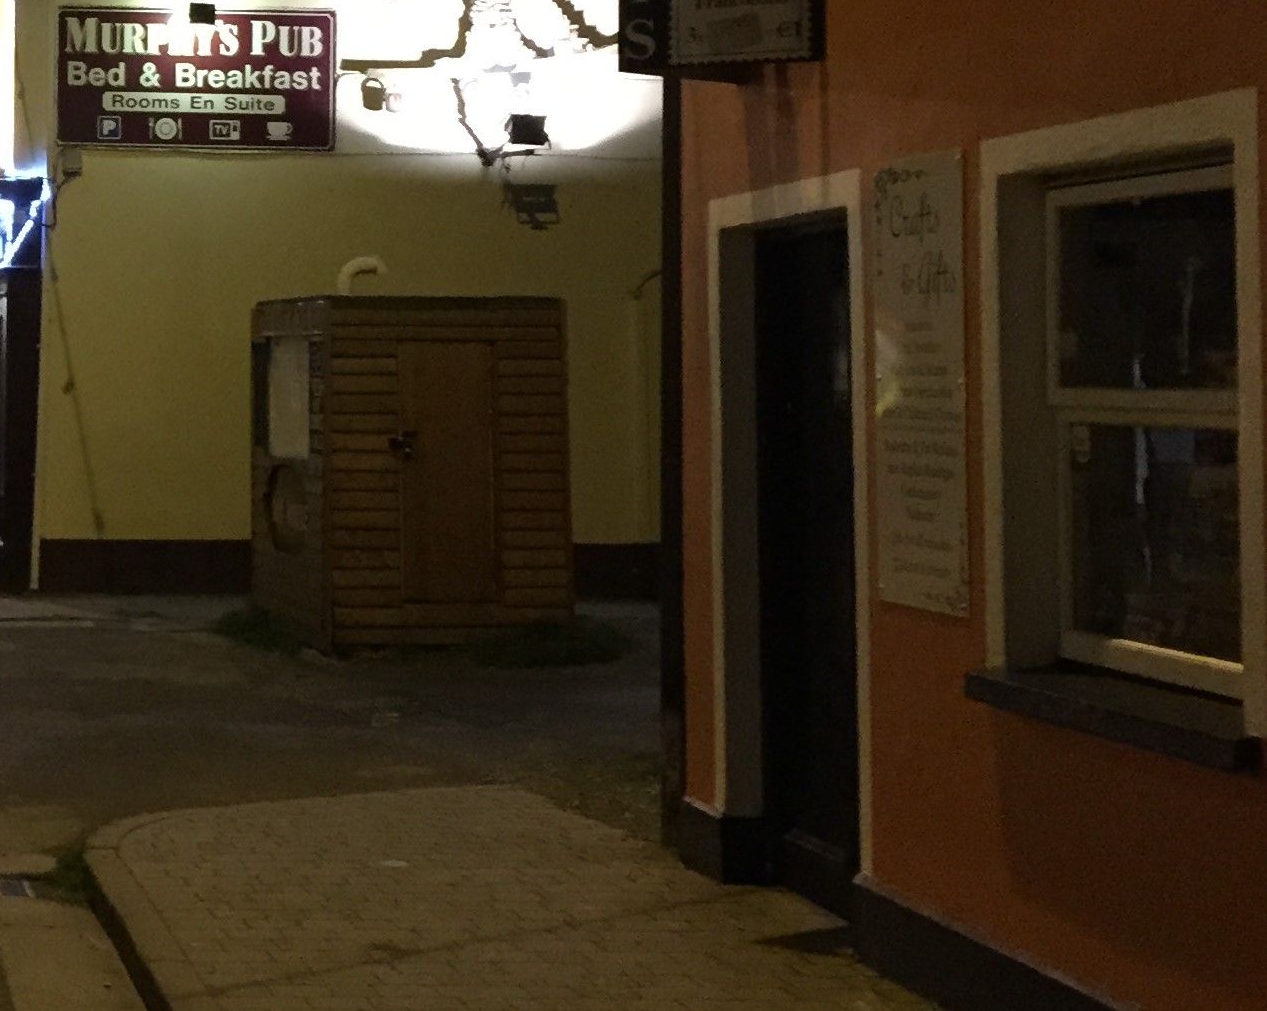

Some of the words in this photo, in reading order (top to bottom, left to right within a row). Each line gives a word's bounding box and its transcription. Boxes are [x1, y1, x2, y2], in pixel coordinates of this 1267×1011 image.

[65, 16, 240, 57] MURPY'S
[250, 19, 324, 57] PUB
[67, 60, 126, 87] Bed
[139, 61, 162, 88] &
[175, 61, 322, 90] Breakfast
[111, 94, 180, 109] Rooms
[191, 96, 215, 110] En
[224, 97, 276, 112] Suite
